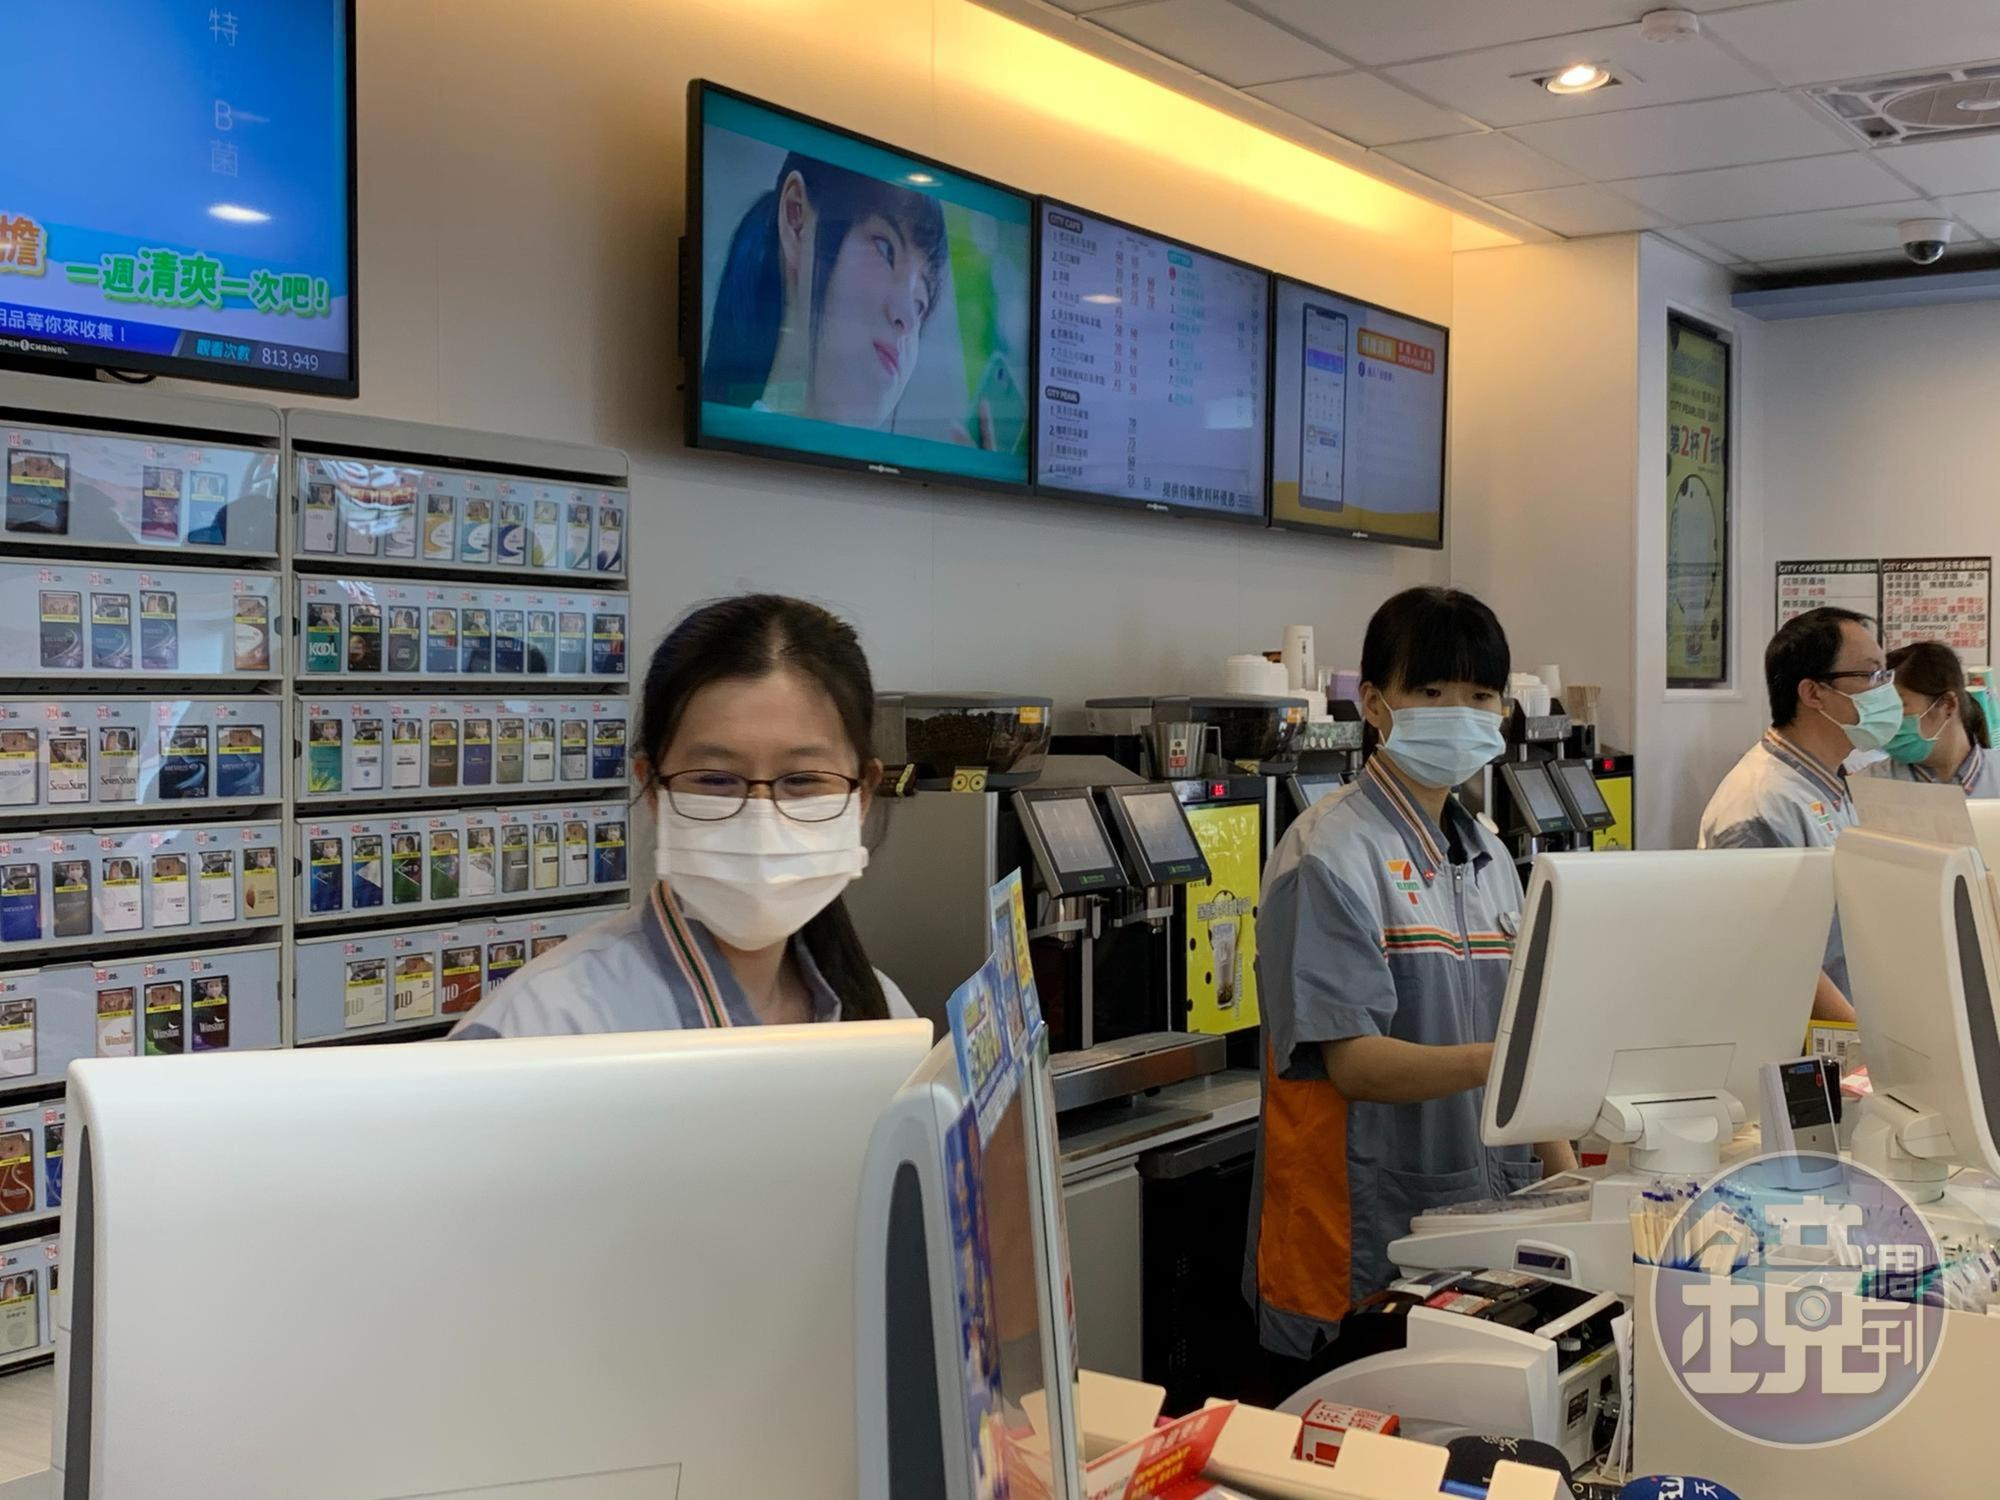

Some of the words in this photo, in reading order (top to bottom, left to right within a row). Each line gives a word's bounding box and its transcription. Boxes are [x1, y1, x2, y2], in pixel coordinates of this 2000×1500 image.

[209, 7, 239, 47] 特
[262, 347, 319, 371] 813,949
[1670, 424, 1721, 465] 第2杯7折
[1778, 564, 1797, 573] CITY
[309, 642, 338, 656] KOOL
[422, 981, 430, 989] 25
[153, 1028, 179, 1039] Winston
[200, 1022, 224, 1033] Winston
